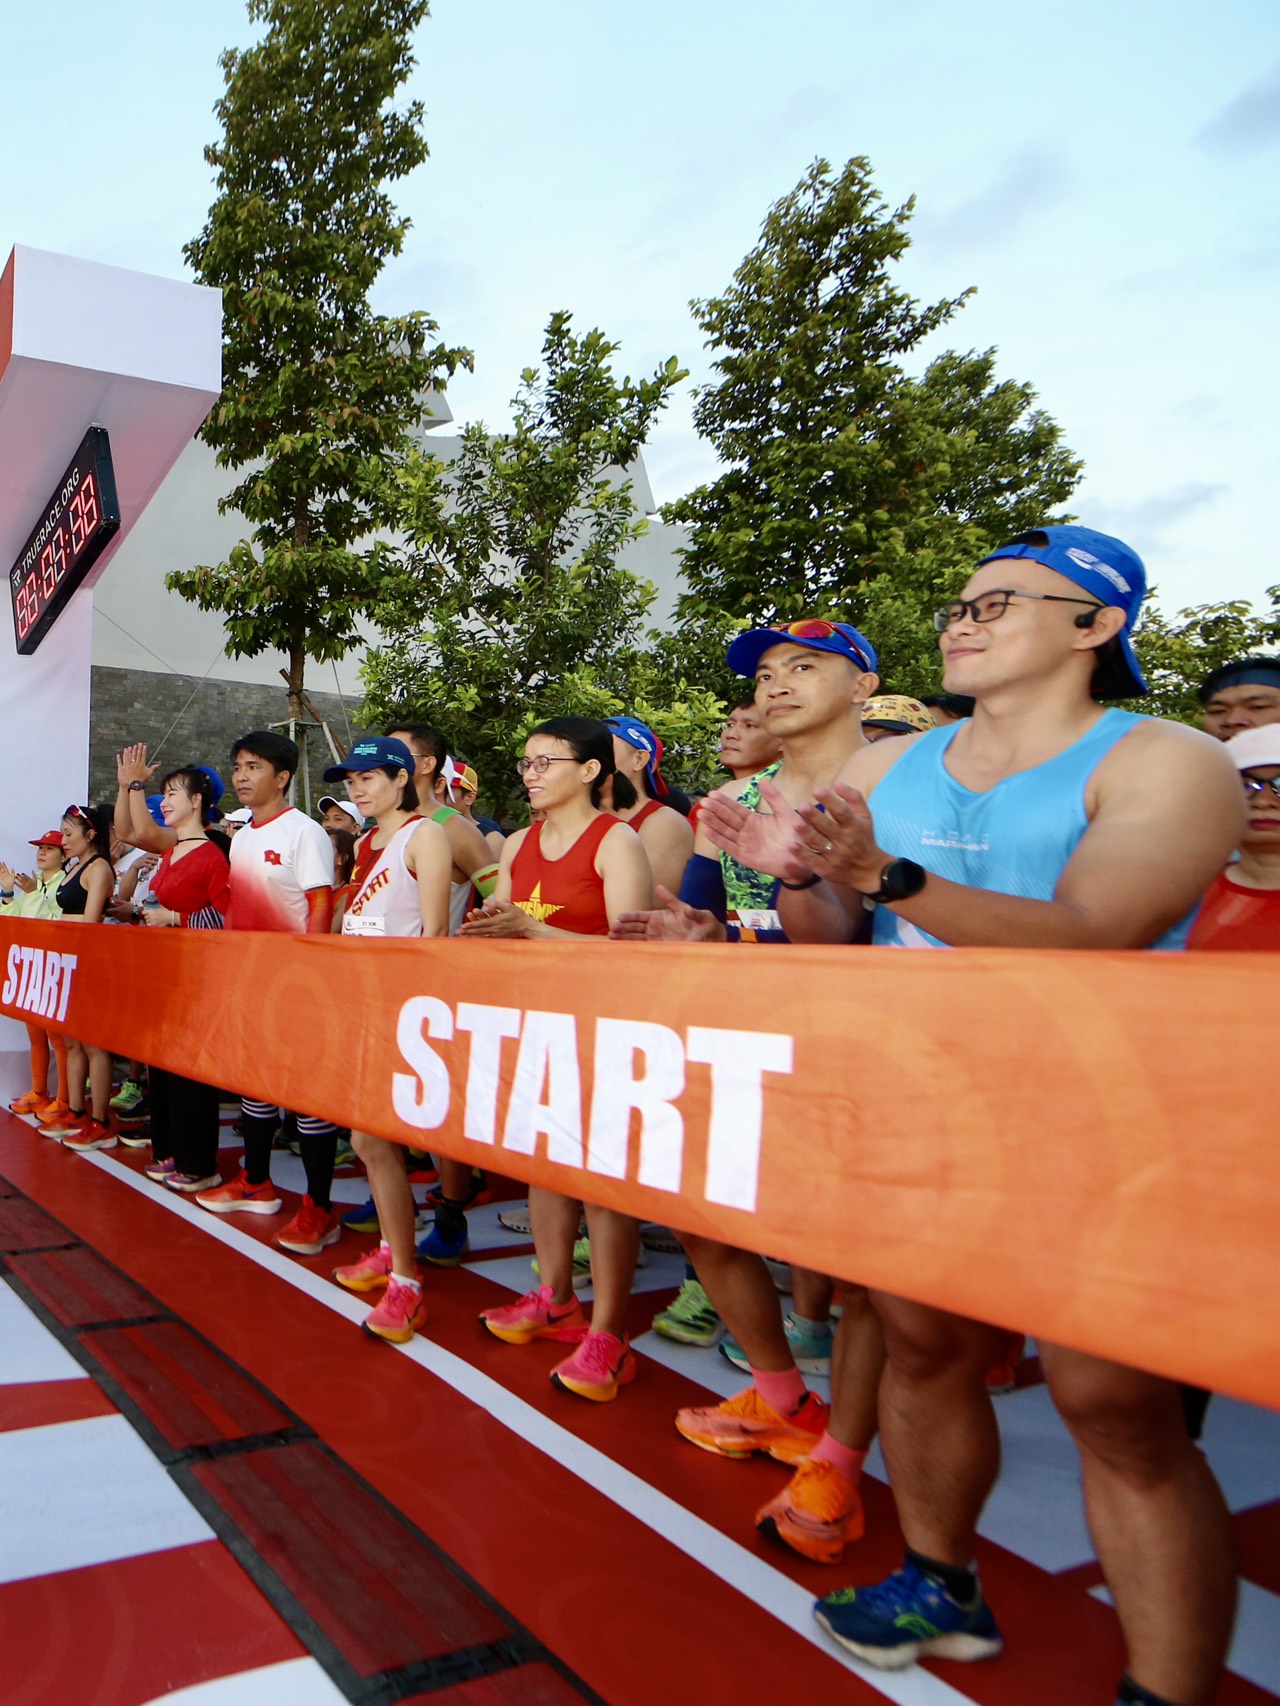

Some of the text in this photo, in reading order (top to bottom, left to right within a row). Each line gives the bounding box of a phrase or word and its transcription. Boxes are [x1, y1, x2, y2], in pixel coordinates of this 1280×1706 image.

[21, 466, 80, 574] TRUERACE.ORG
[352, 867, 390, 916] SPORT
[1, 943, 78, 1022] START
[391, 995, 794, 1213] START
